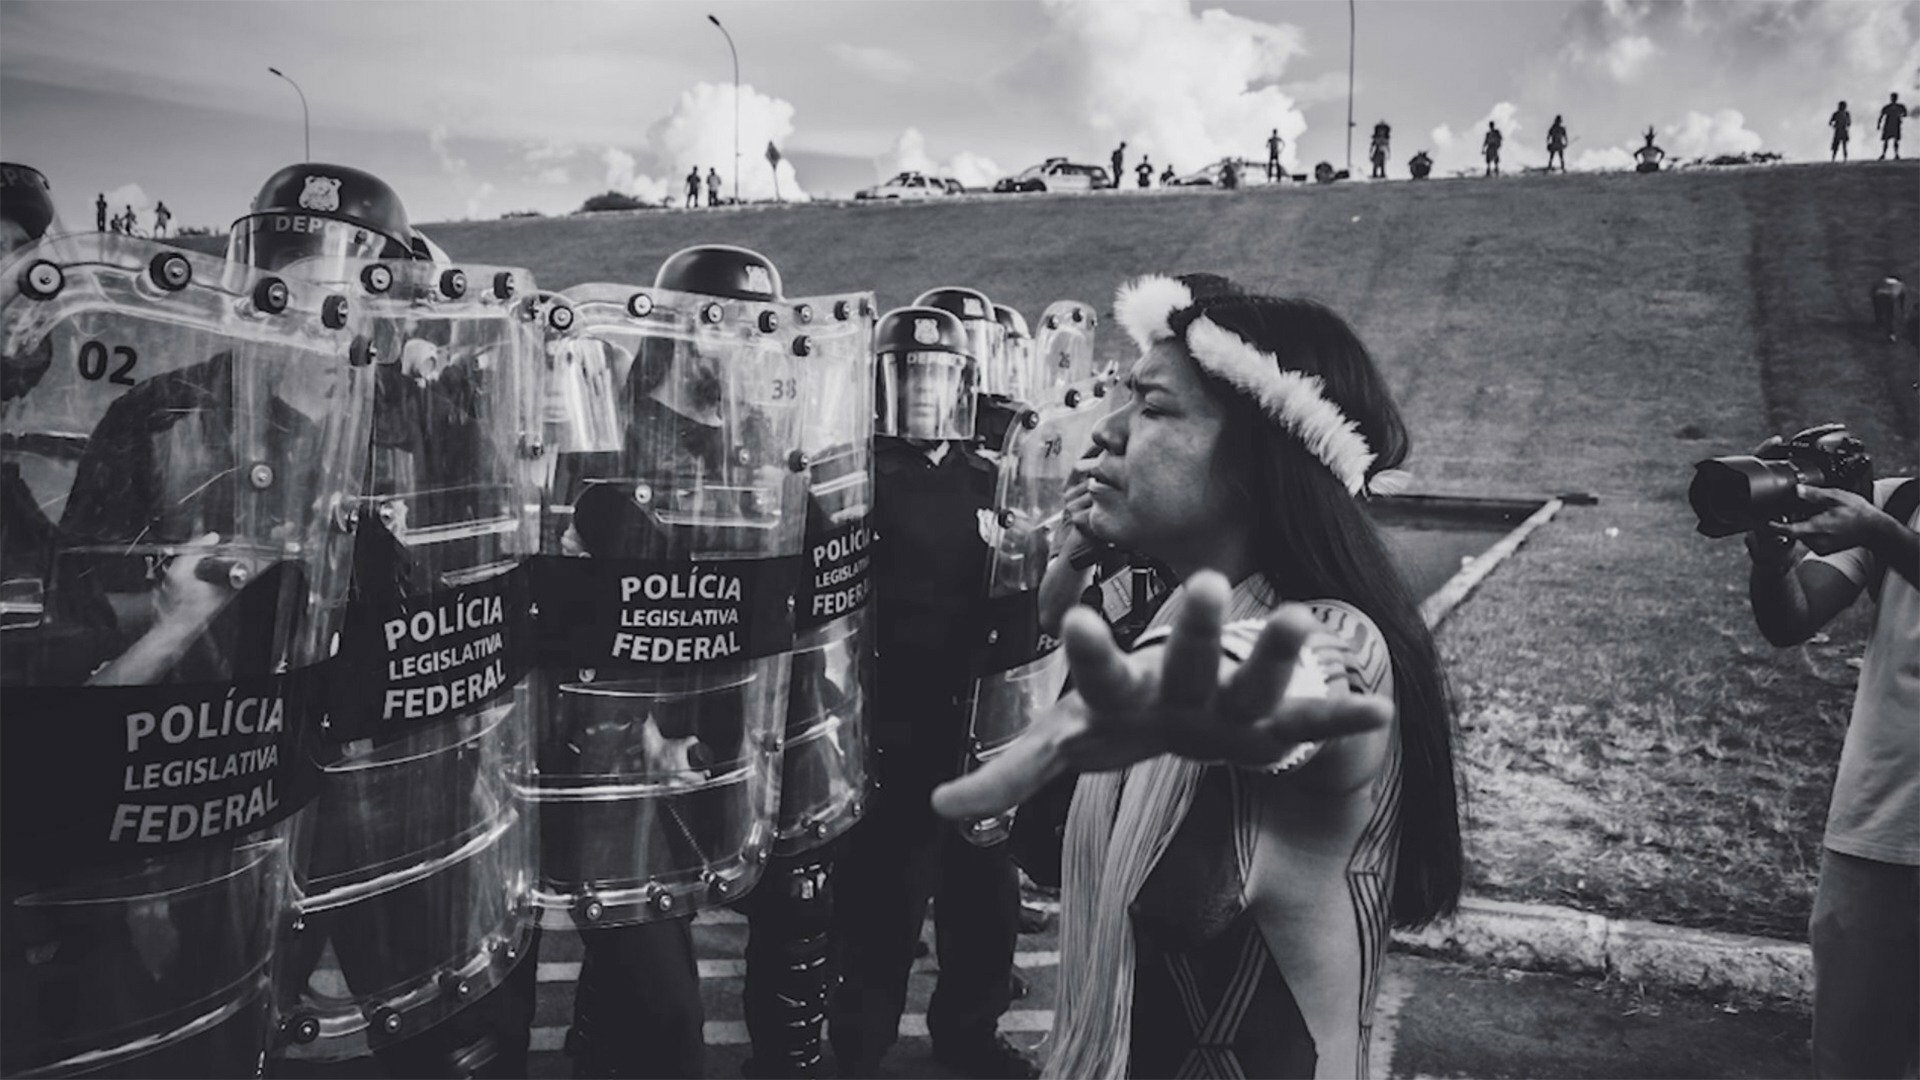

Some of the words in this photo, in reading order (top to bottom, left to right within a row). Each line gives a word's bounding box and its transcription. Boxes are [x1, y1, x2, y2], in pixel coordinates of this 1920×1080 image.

[78, 341, 138, 386] 02
[621, 566, 741, 602] POLÍCIA
[384, 593, 503, 652] POLÍCIA
[620, 608, 739, 627] LEGISLATIVA
[388, 632, 503, 681] LEGISLATIVA
[611, 631, 741, 663] FEDERAL
[382, 658, 506, 720] FEDERAL
[126, 687, 284, 752] POLÍCIA
[124, 744, 279, 792] LEGISLATIVA
[109, 779, 280, 843] FEDERAL
